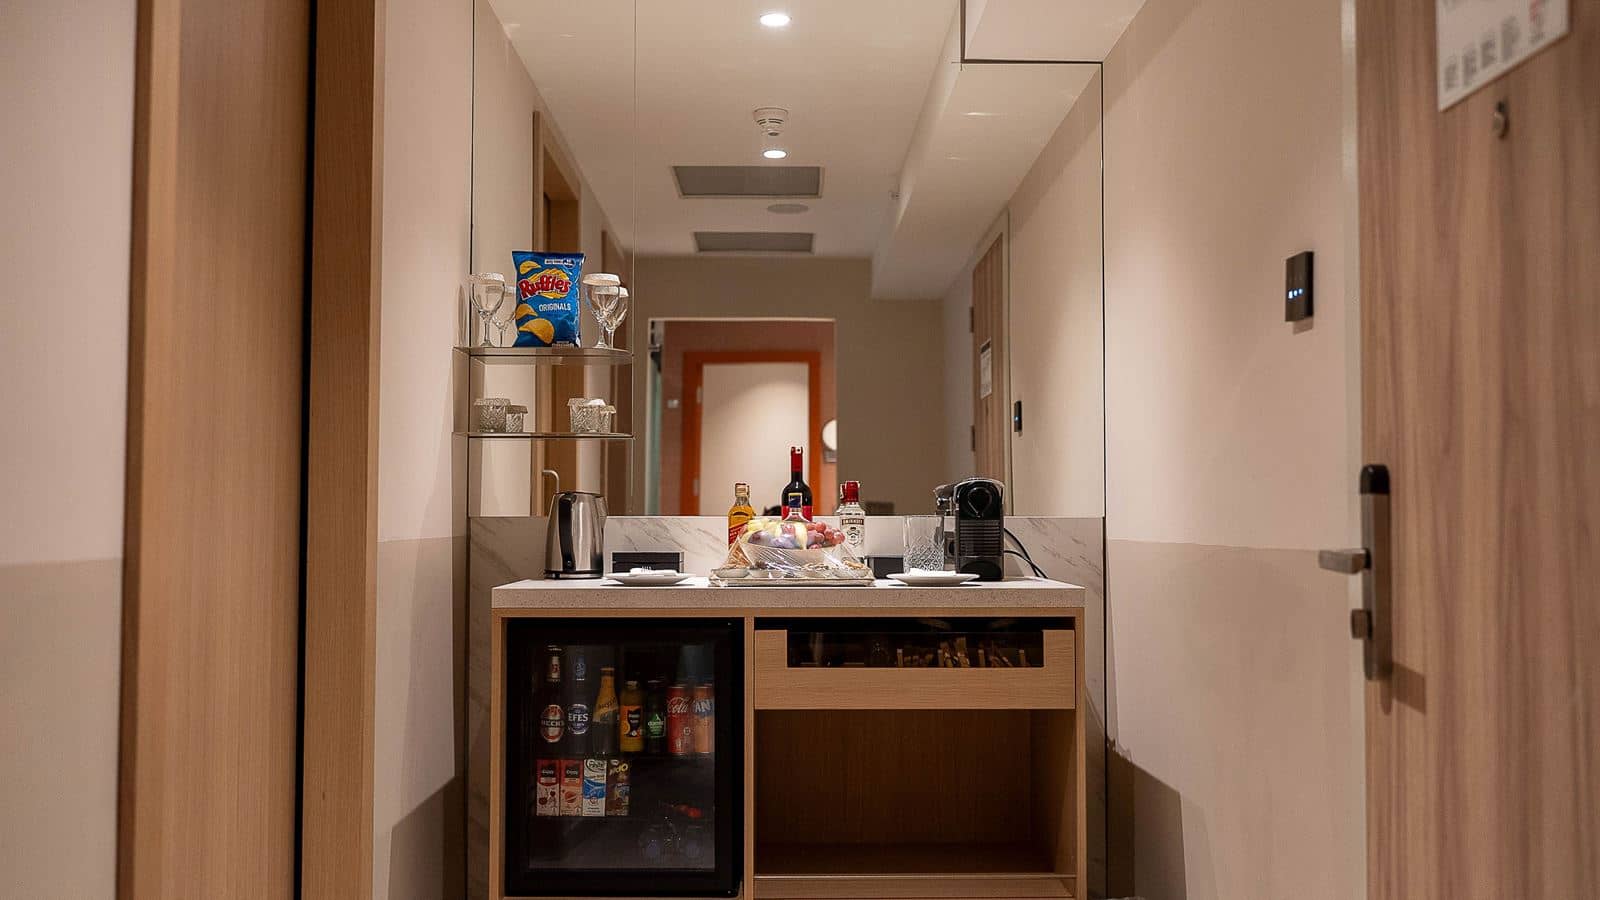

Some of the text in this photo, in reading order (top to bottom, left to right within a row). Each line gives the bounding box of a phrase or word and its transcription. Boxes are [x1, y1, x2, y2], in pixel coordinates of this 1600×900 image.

[518, 274, 572, 300] Ruffles
[538, 303, 571, 312] ORIGINALS
[567, 713, 589, 722] EFES
